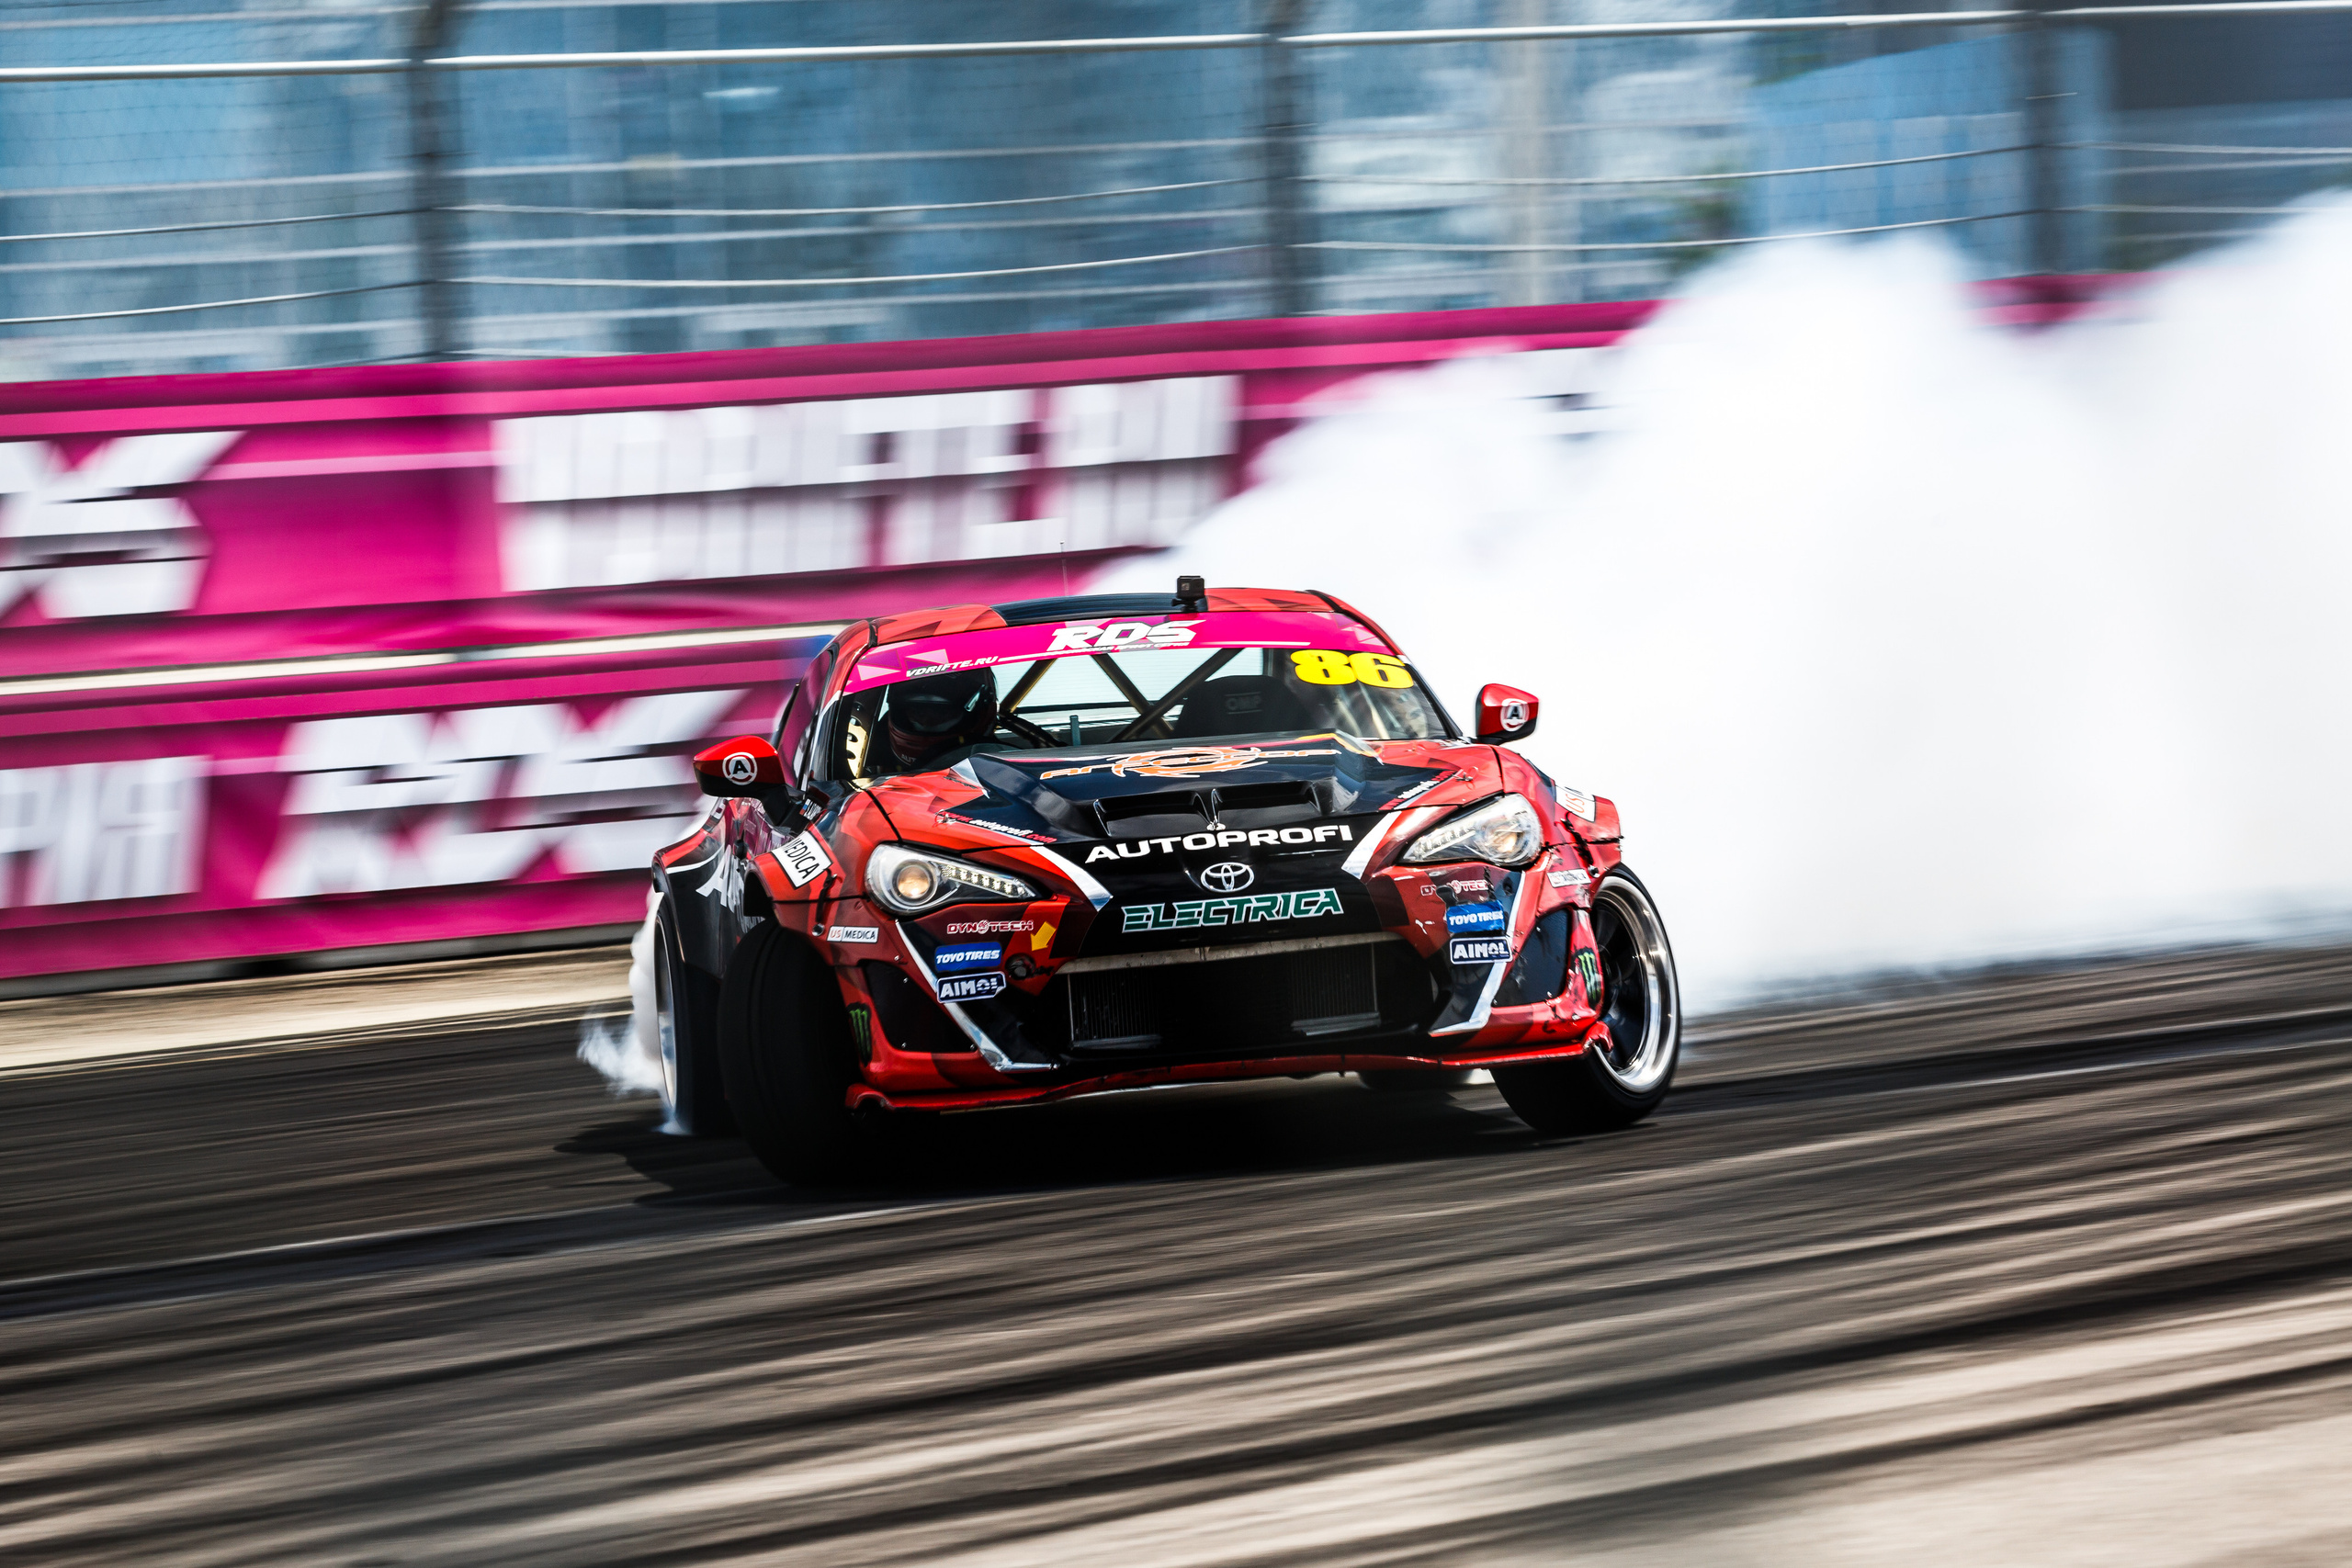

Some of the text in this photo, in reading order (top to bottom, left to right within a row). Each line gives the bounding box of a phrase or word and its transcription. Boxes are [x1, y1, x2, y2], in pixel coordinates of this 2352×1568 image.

[1046, 620, 1206, 651] RDS
[906, 656, 999, 677] VDRIFTE.RU
[1290, 649, 1415, 689] 86
[1084, 825, 1353, 863] AUTOPROFI
[1121, 887, 1344, 934] ELECTRICA
[1448, 909, 1504, 926] TOYO TIRES
[831, 930, 876, 940] US MEDICA
[946, 919, 1035, 935] DYNOTECH
[935, 949, 1001, 964] TOYO TIRES
[1453, 942, 1510, 960] AIMOL
